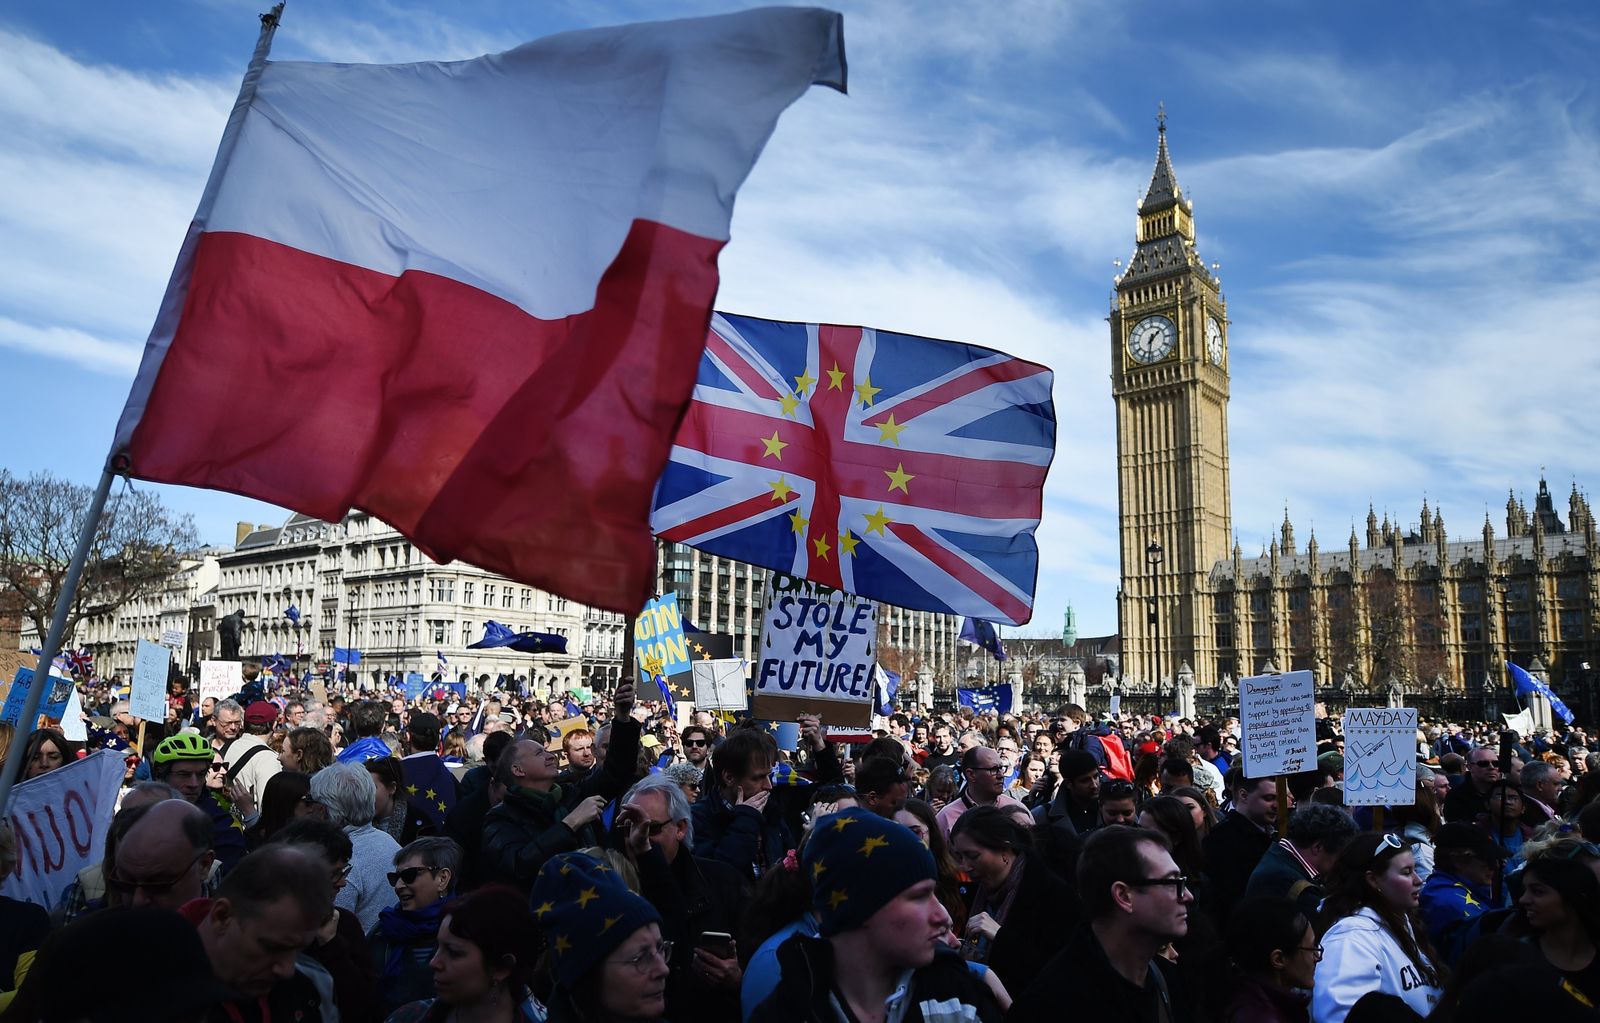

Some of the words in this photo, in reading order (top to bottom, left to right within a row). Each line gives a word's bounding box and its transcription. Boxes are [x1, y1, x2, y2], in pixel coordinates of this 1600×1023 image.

[773, 596, 872, 635] STOLE
[793, 629, 849, 660] MY
[757, 658, 876, 698] FUTURE!
[1253, 698, 1273, 709] political
[1274, 696, 1289, 704] leader
[1248, 710, 1269, 720] support
[1272, 707, 1279, 718] by
[1280, 705, 1304, 717] appealing
[1348, 711, 1415, 727] MAYDAY
[1248, 720, 1269, 731] popular
[1271, 718, 1290, 727] desires
[1248, 731, 1278, 741] prejudices
[1279, 727, 1295, 736] rather
[1249, 743, 1258, 753] by
[1260, 740, 1276, 750] using
[1249, 750, 1277, 763] argument
